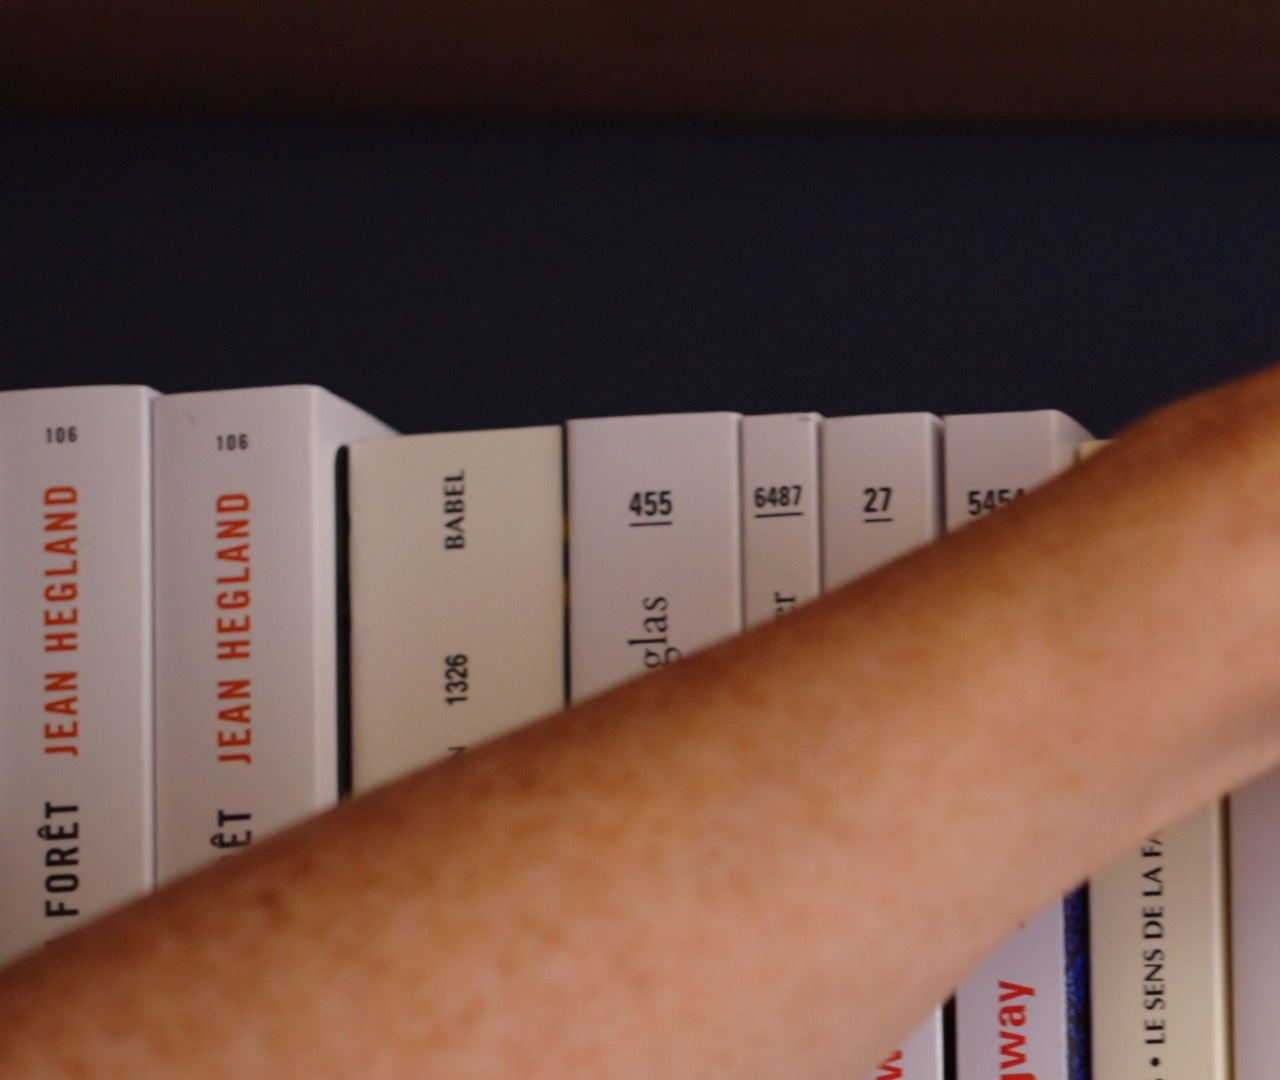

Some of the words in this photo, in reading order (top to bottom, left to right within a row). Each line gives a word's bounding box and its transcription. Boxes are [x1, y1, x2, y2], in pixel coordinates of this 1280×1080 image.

[45, 426, 78, 444] 106
[216, 434, 249, 451] 106
[444, 469, 466, 550] BABEL
[629, 490, 673, 517] 455
[754, 486, 803, 507] 6487
[863, 487, 892, 513] 27
[968, 488, 1024, 516] 545
[44, 484, 78, 652] HEGLAND
[217, 492, 251, 661] HEGLAND
[446, 653, 469, 706] 1326
[44, 670, 78, 756] JEAN
[217, 678, 251, 764] JEAN
[37, 801, 80, 918] FORÊT
[1142, 866, 1163, 896] LA
[1142, 905, 1164, 939] DE
[1143, 949, 1165, 1010] SENS
[1145, 1019, 1166, 1045] LE
